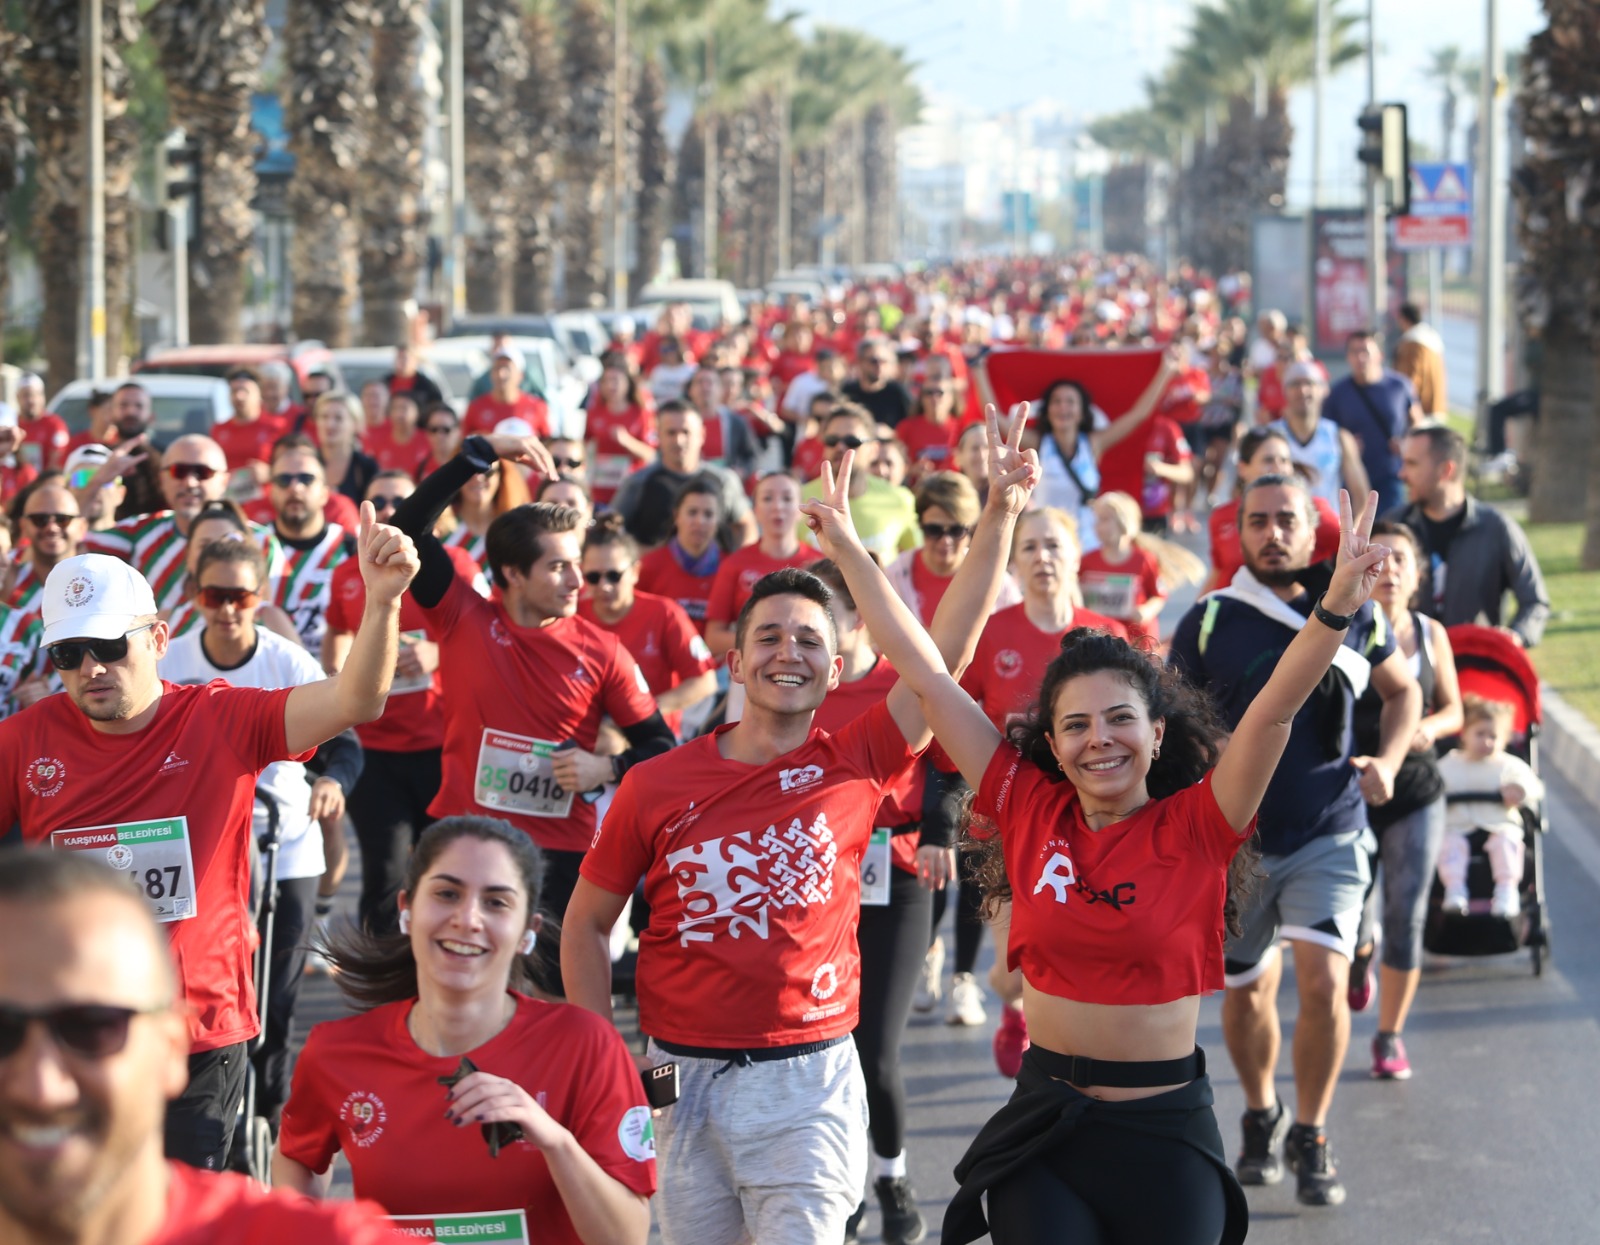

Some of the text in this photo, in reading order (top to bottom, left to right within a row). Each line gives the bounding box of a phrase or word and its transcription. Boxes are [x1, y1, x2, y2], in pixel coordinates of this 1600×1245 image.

[64, 825, 172, 846] KARŞIYAKA BELEDİYESİ
[435, 1220, 506, 1237] BELEDİYESİ
